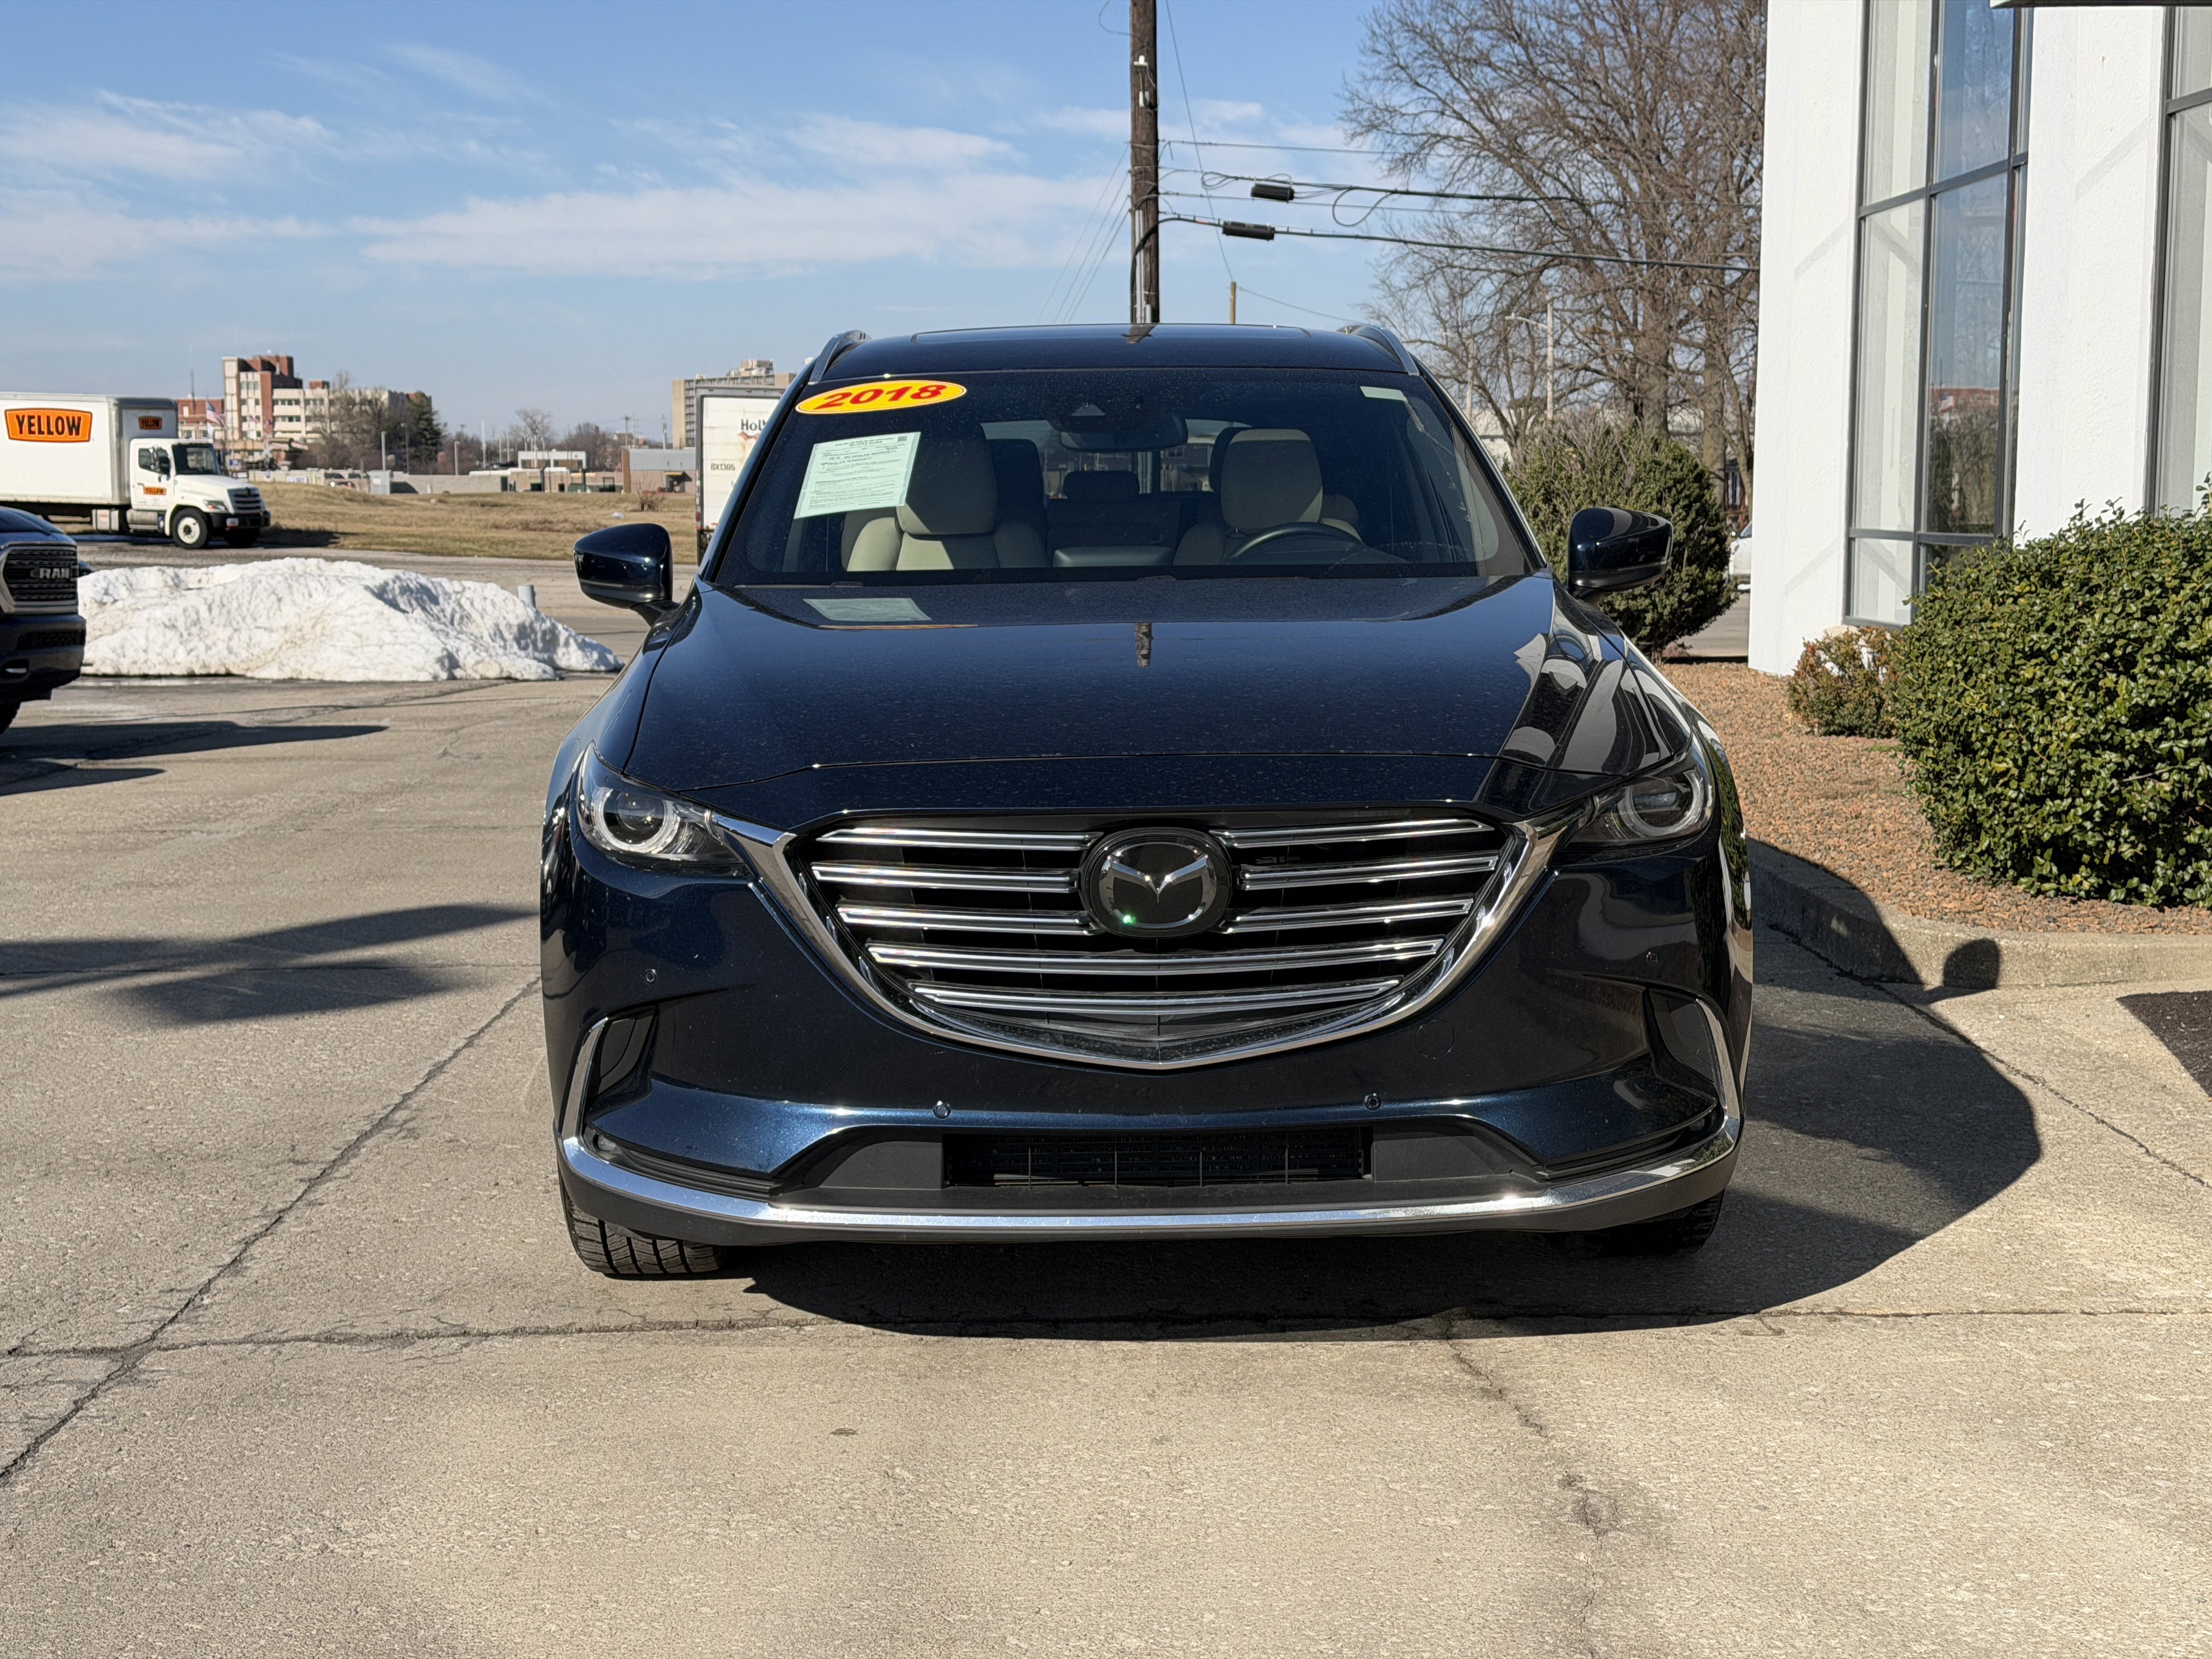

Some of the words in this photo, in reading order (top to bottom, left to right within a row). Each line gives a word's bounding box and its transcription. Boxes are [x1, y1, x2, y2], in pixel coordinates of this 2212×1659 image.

[812, 385, 948, 410] 2018
[15, 414, 82, 437] YELLOW
[40, 567, 70, 580] RAM
